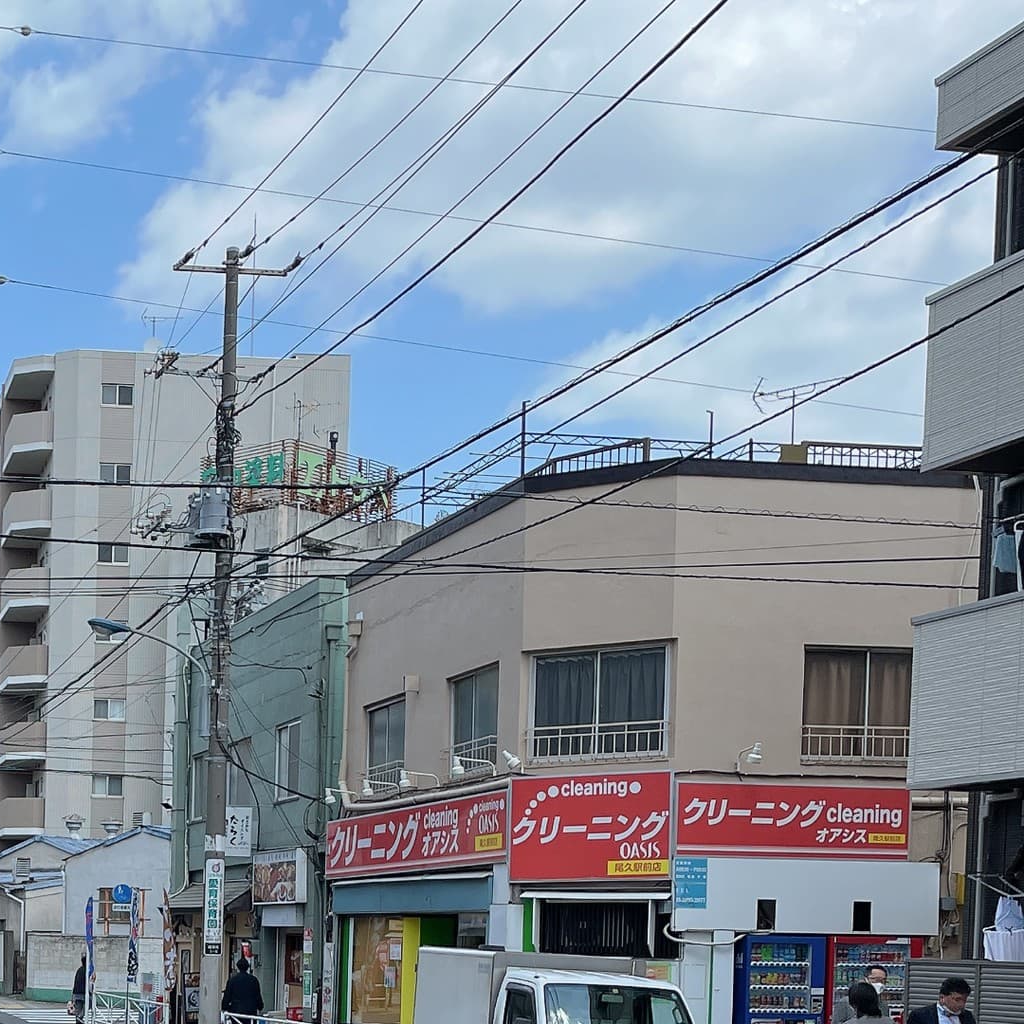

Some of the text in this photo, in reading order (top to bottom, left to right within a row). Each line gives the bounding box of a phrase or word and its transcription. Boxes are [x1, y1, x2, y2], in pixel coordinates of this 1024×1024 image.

[561, 778, 628, 797] cleaning
[423, 806, 459, 830] cleaning
[683, 797, 903, 828] クリーニング cleaning
[512, 810, 670, 846] クリーニング
[816, 828, 866, 843] オアシス
[330, 813, 421, 868] クリーニング
[421, 828, 459, 857] オアシス
[620, 842, 661, 859] OASIS
[614, 861, 662, 873] 尾久駅前店
